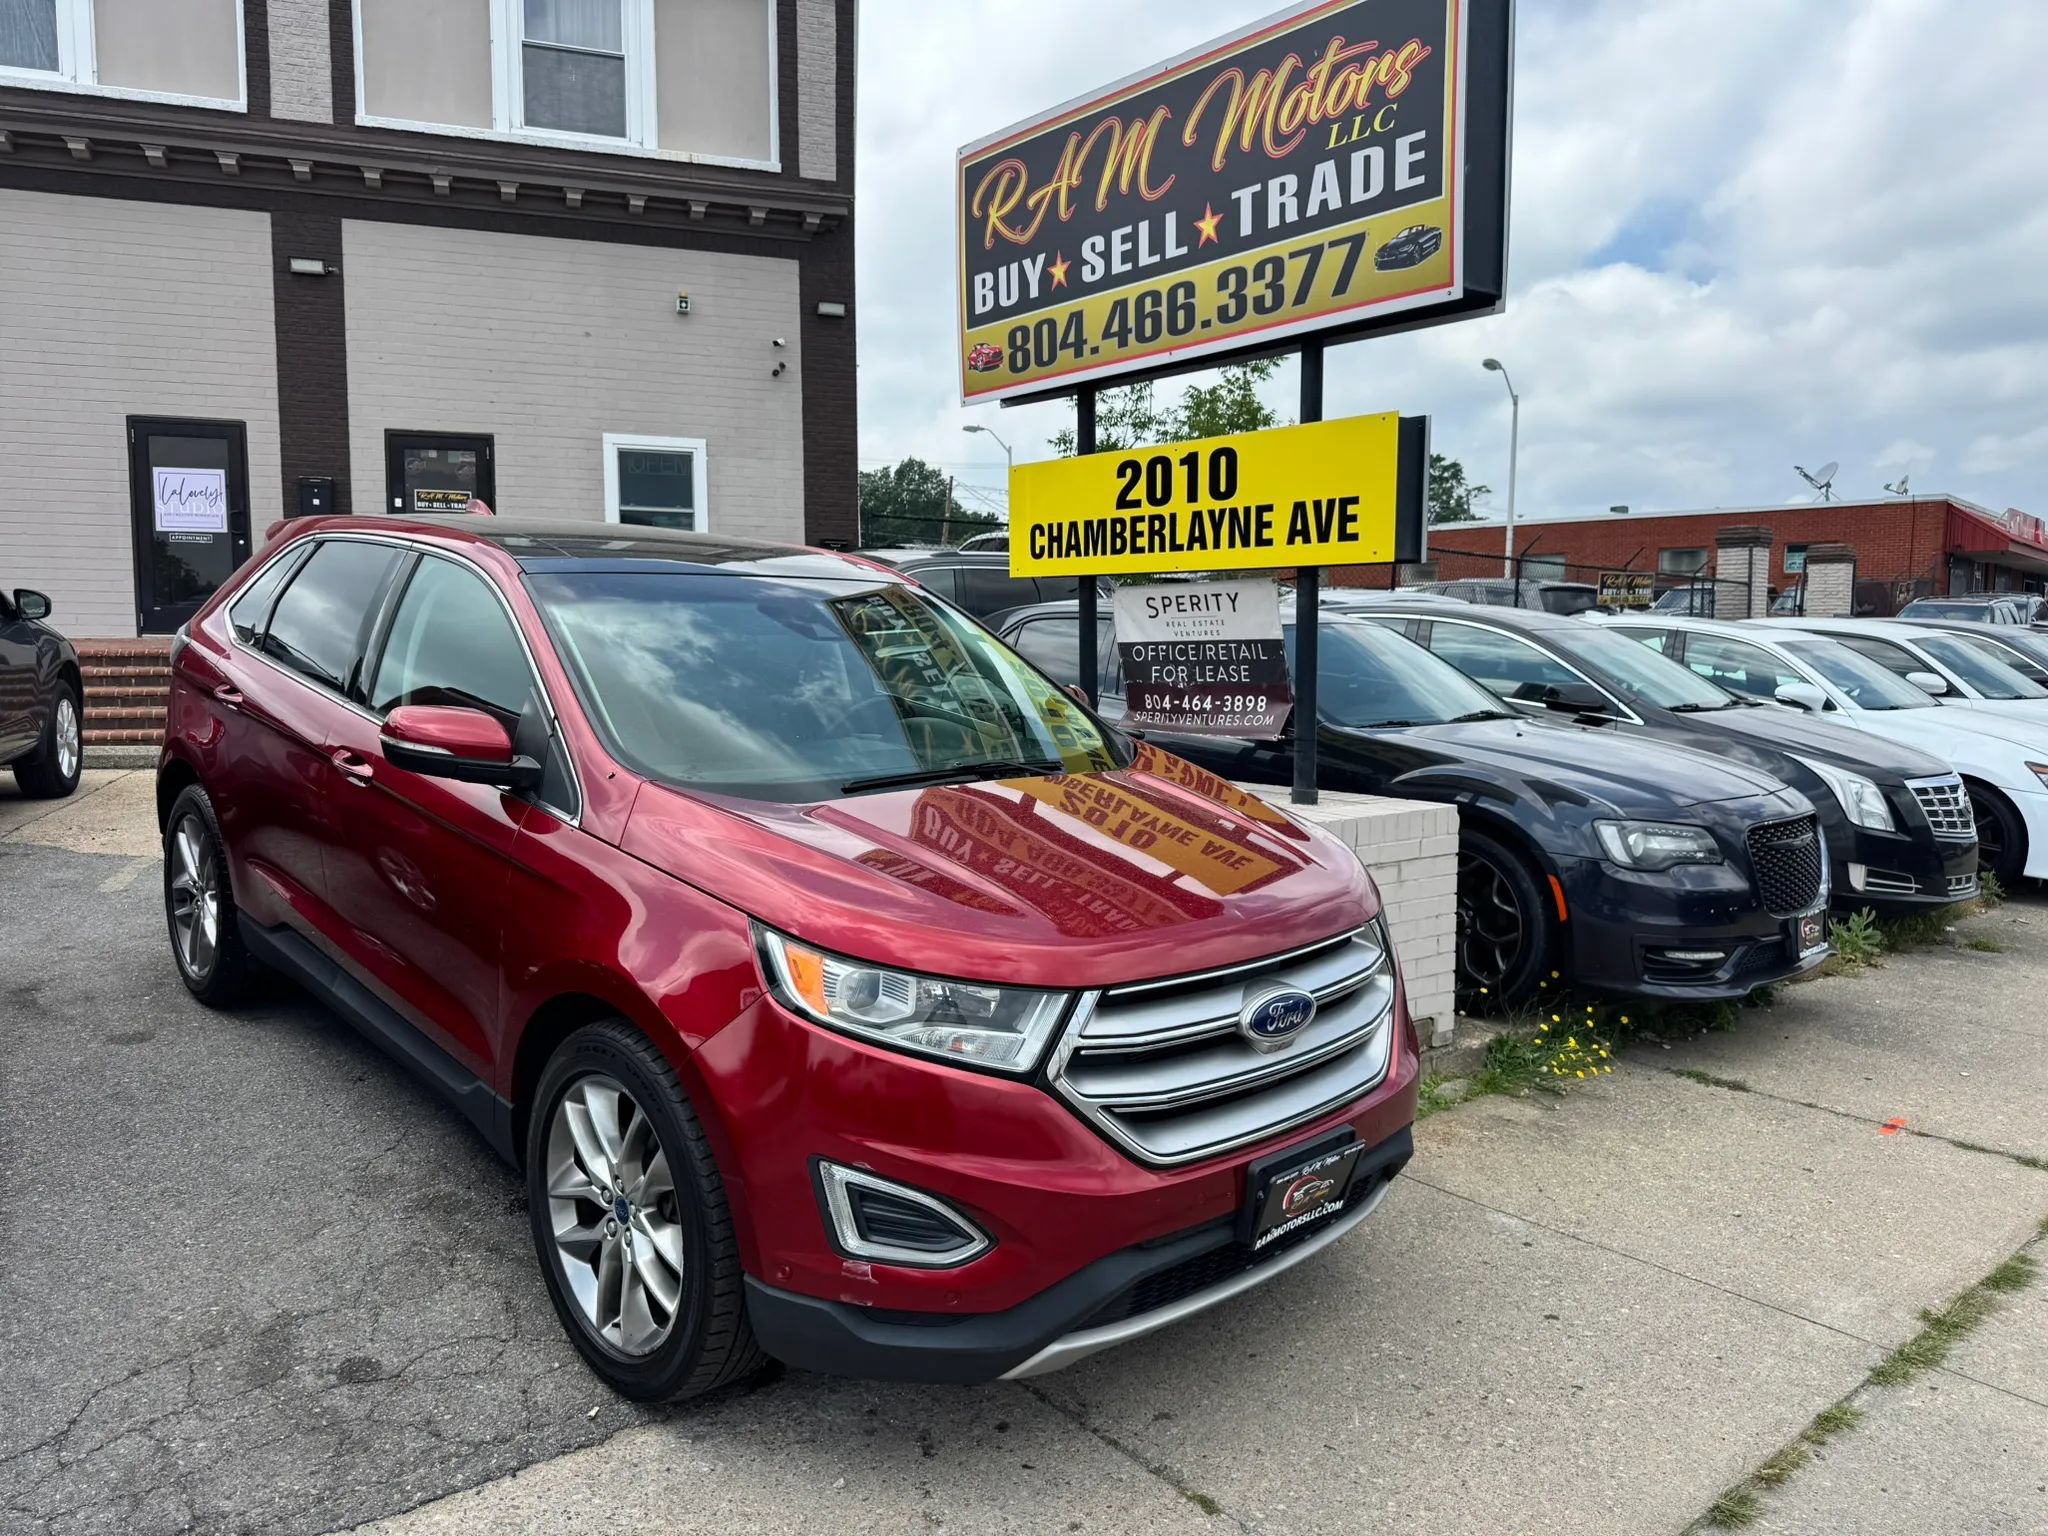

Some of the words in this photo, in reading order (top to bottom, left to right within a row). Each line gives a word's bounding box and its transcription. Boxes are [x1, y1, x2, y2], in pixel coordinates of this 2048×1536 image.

[1324, 103, 1398, 150] LLC
[971, 104, 1176, 250] RAM
[1183, 35, 1432, 172] Motors
[973, 252, 1046, 316] BUY
[1081, 210, 1188, 283] SELL
[1231, 129, 1426, 237] TRADE
[1007, 230, 1367, 374] 804.466.3377
[1114, 446, 1239, 510] 2010
[450, 502, 467, 510] TRAD
[1029, 503, 1274, 560] CHAMBERLAYNE
[1285, 496, 1360, 546] AVE
[1146, 592, 1240, 619] SPERITY
[1166, 620, 1187, 628] REAL
[1192, 619, 1225, 627] ESTATE
[1132, 643, 1268, 661] OFFICE/RETAIL
[1151, 666, 1188, 682] FOR
[1196, 665, 1251, 682] LEASE
[1144, 693, 1267, 712] 804-464-3898
[1133, 711, 1274, 726] SPERITYVENTURES.COM
[1266, 999, 1304, 1032] Ford
